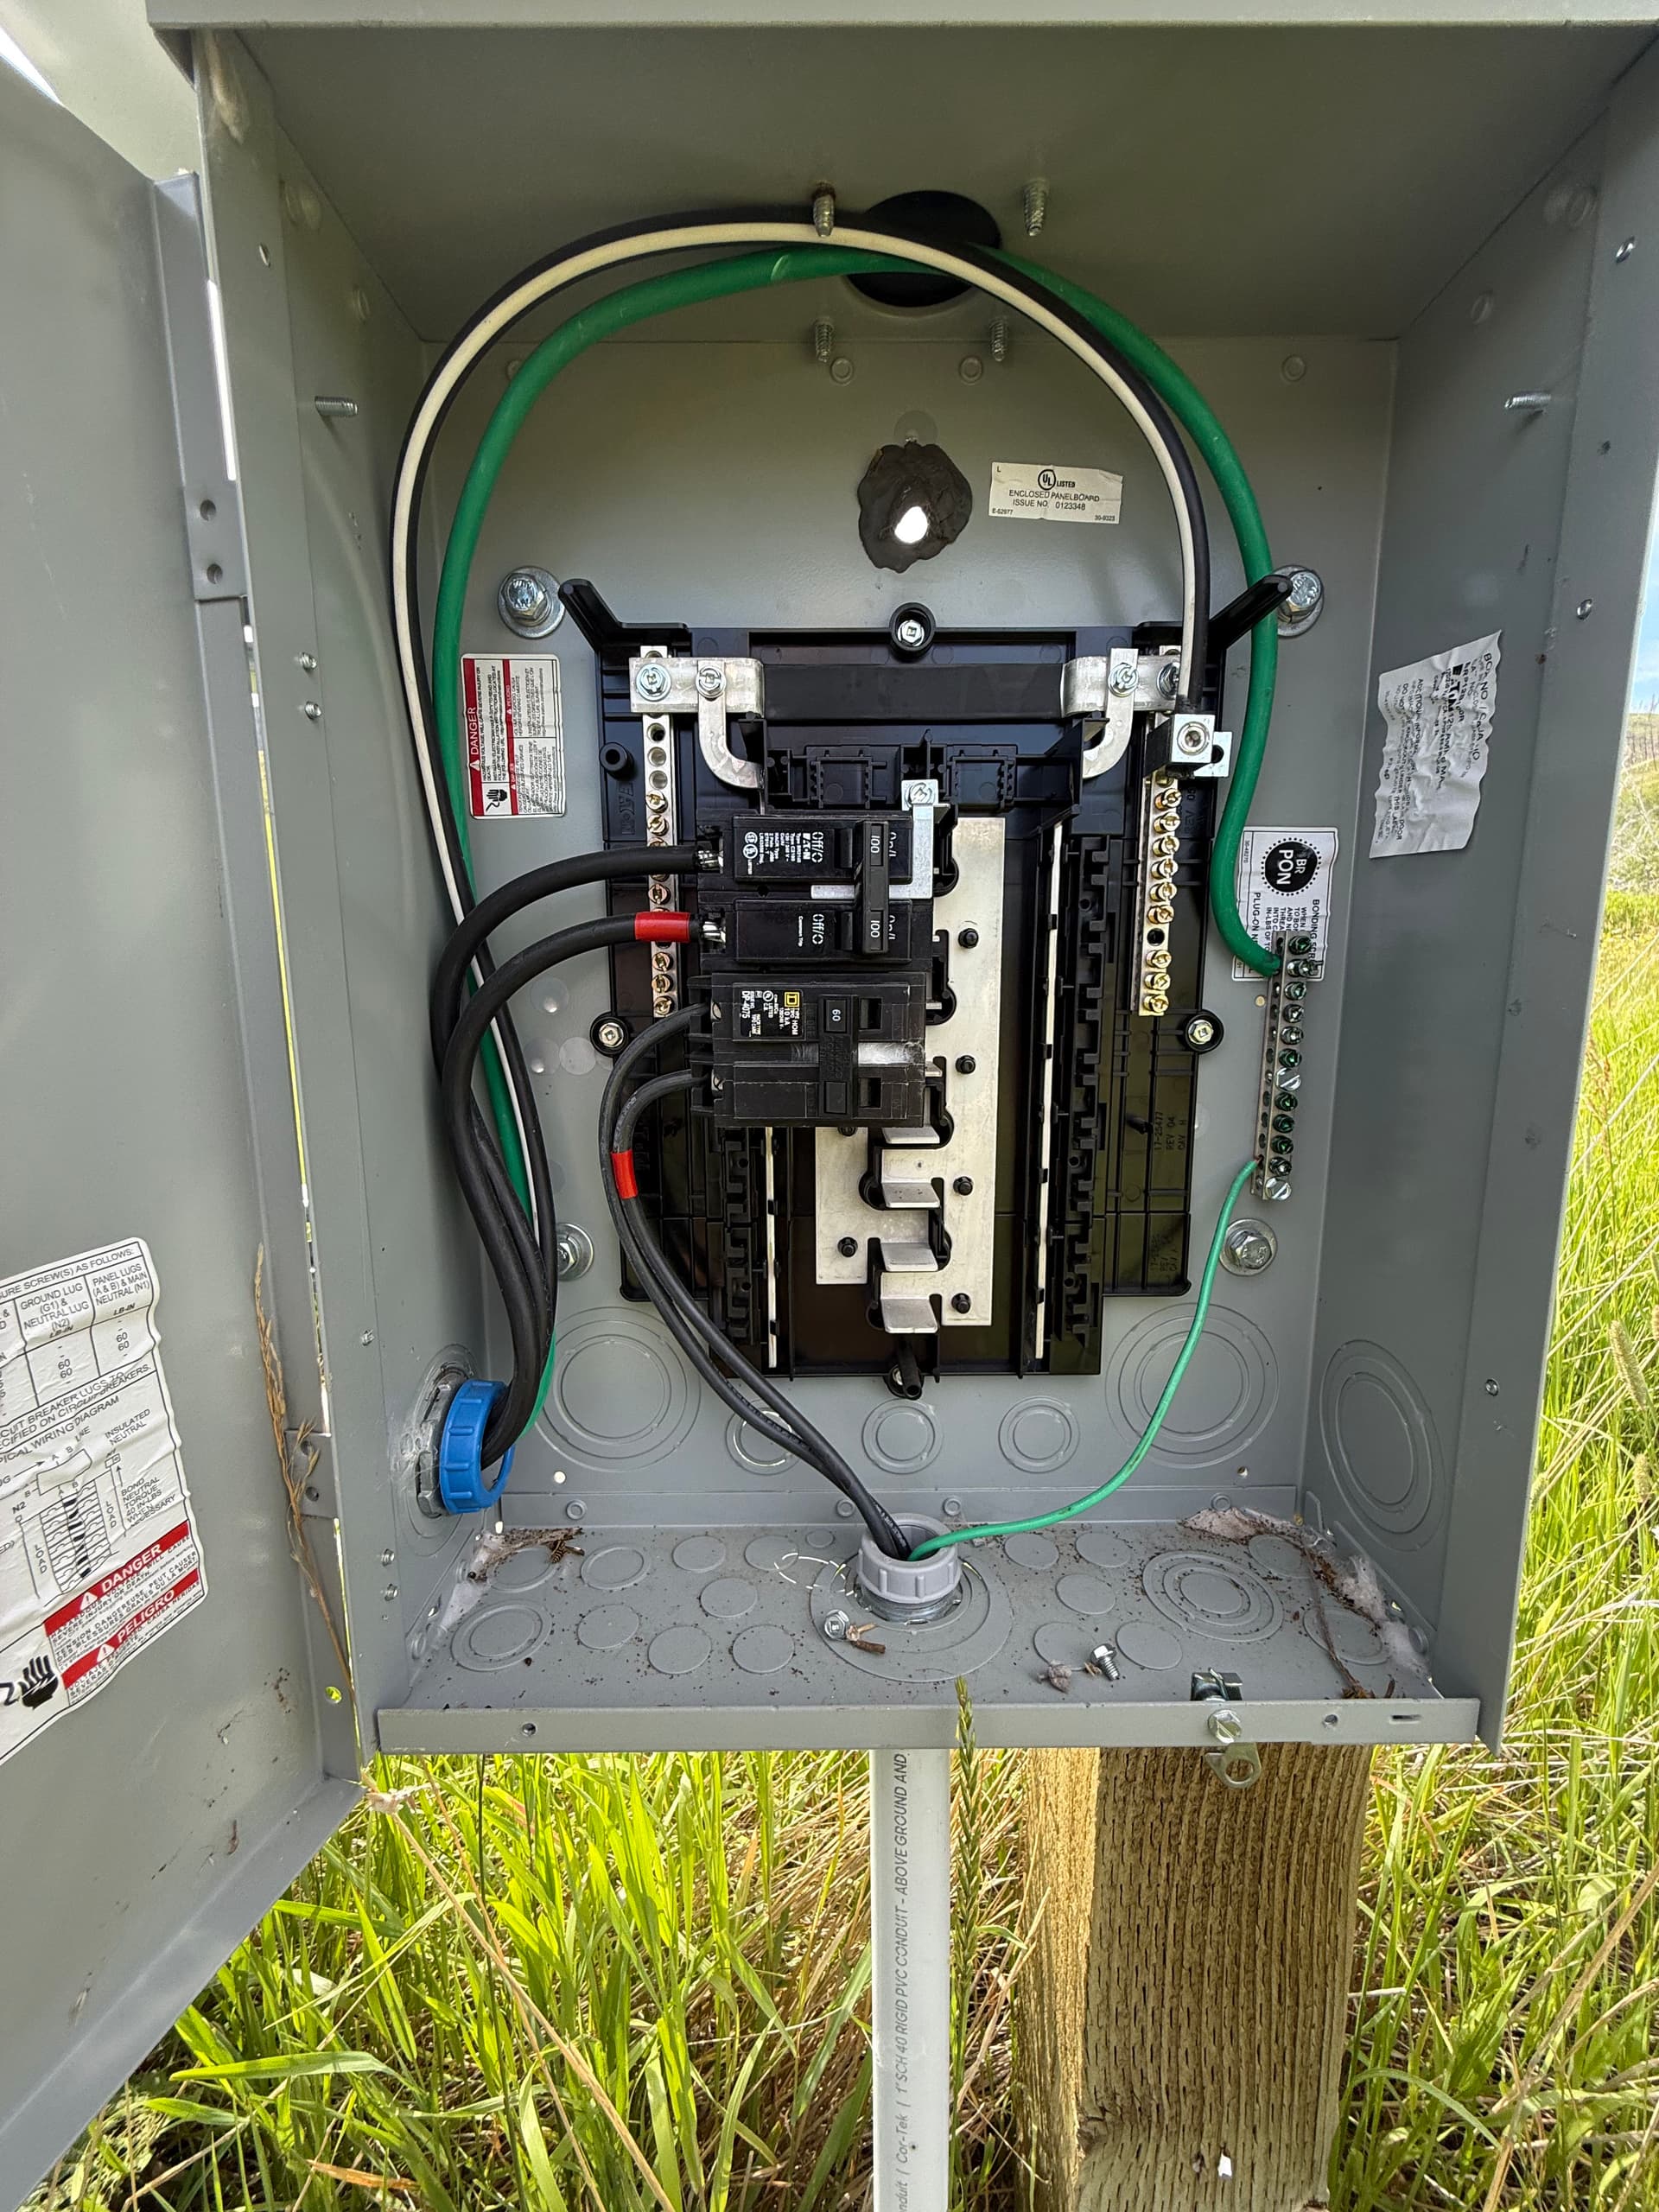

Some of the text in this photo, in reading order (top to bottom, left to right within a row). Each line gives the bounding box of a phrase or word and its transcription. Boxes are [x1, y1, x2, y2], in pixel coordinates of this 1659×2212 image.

[1051, 493, 1099, 501] PANELBOARD
[467, 706, 479, 754] DANGER
[869, 835, 880, 853] 100
[1275, 849, 1294, 886] PON
[1294, 858, 1306, 874] BR
[1250, 892, 1261, 931] PLUG-ON
[1294, 906, 1300, 916] TO
[869, 920, 880, 938] 100
[1264, 931, 1270, 940] OF
[1307, 899, 1319, 961] BONDING SCR
[831, 1008, 841, 1021] 60
[22, 1266, 74, 1290] SCREW(S)
[74, 1262, 89, 1273] AS
[89, 1247, 134, 1268] FOLLOWS:
[92, 1262, 142, 1286] PANEL LUGS
[19, 1282, 83, 1310] GROUND LUG
[92, 1287, 101, 1296] (A
[110, 1281, 119, 1291] B)
[127, 1271, 147, 1283] MAIN
[95, 1280, 150, 1306] NEUTRAL (N1)
[23, 1300, 89, 1329] NEUTRAL LUG
[38, 1297, 67, 1313] (G1) &
[51, 1317, 70, 1330] (N2)
[115, 1332, 128, 1342] 60
[117, 1340, 130, 1351] 60
[57, 1358, 71, 1370] 60
[59, 1367, 73, 1378] 60
[26, 1392, 79, 1425] BREAKER
[78, 1378, 108, 1398] LUGS
[31, 1422, 74, 1449] WIRING
[73, 1395, 119, 1426] DIAGRAM
[38, 1413, 58, 1427] ON
[105, 1408, 150, 1439] INSULATED
[108, 1420, 146, 1445] NEUTRAL
[119, 1477, 145, 1496] BOND
[122, 1476, 160, 1503] NEUTRAL
[124, 1485, 158, 1509] TORQUE
[134, 1489, 162, 1508] IN-LBS
[11, 1501, 27, 1513] N2
[126, 1503, 154, 1522] WHEN
[99, 1543, 162, 1592] DANGER
[145, 1554, 164, 1568] WILL
[54, 1628, 91, 1656] TENSION
[149, 1573, 167, 1587] PEUT
[168, 1550, 196, 1573] CAUSER
[115, 1588, 177, 1643] PELIGRO
[52, 1618, 83, 1643] SEVERE
[85, 1598, 112, 1618] INJURY
[56, 1647, 73, 1662] DES
[155, 1580, 167, 1590] OU
[893, 1753, 906, 1783] AND
[894, 1786, 907, 1846] GROUND
[894, 1847, 907, 1895] ABOVE
[894, 1905, 908, 1966] CONDUIT
[894, 1968, 907, 1996] PVC
[894, 1998, 907, 2035] RIGID
[895, 2037, 907, 2053] 40
[894, 2055, 907, 2082] SCH
[896, 2114, 908, 2164] Cor-Tek
